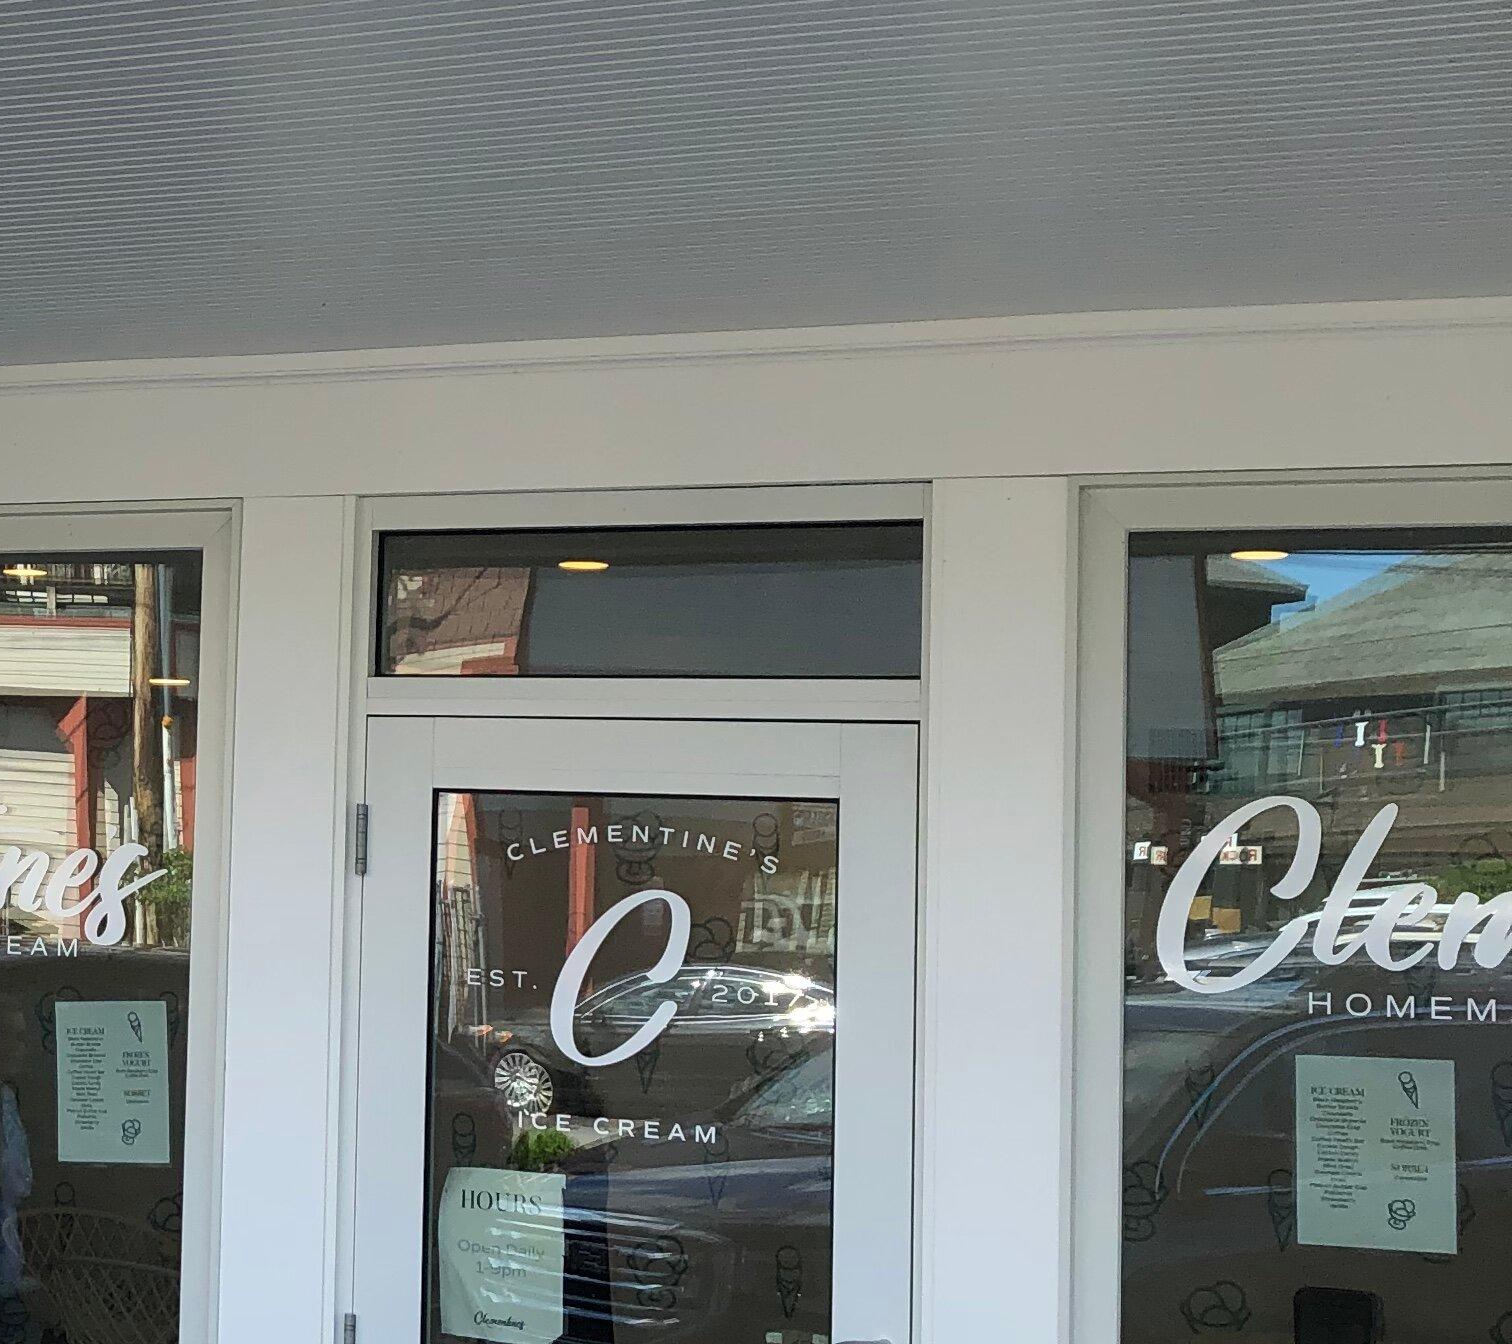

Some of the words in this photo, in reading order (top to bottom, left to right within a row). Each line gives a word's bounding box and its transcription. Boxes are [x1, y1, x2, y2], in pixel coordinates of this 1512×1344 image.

[506, 824, 780, 875] CLEMENTINE'S
[467, 967, 539, 990] EST.
[550, 889, 691, 1067] C
[517, 1109, 572, 1132] ICE
[593, 1117, 717, 1144] CREAM
[461, 1189, 542, 1214] HOURS
